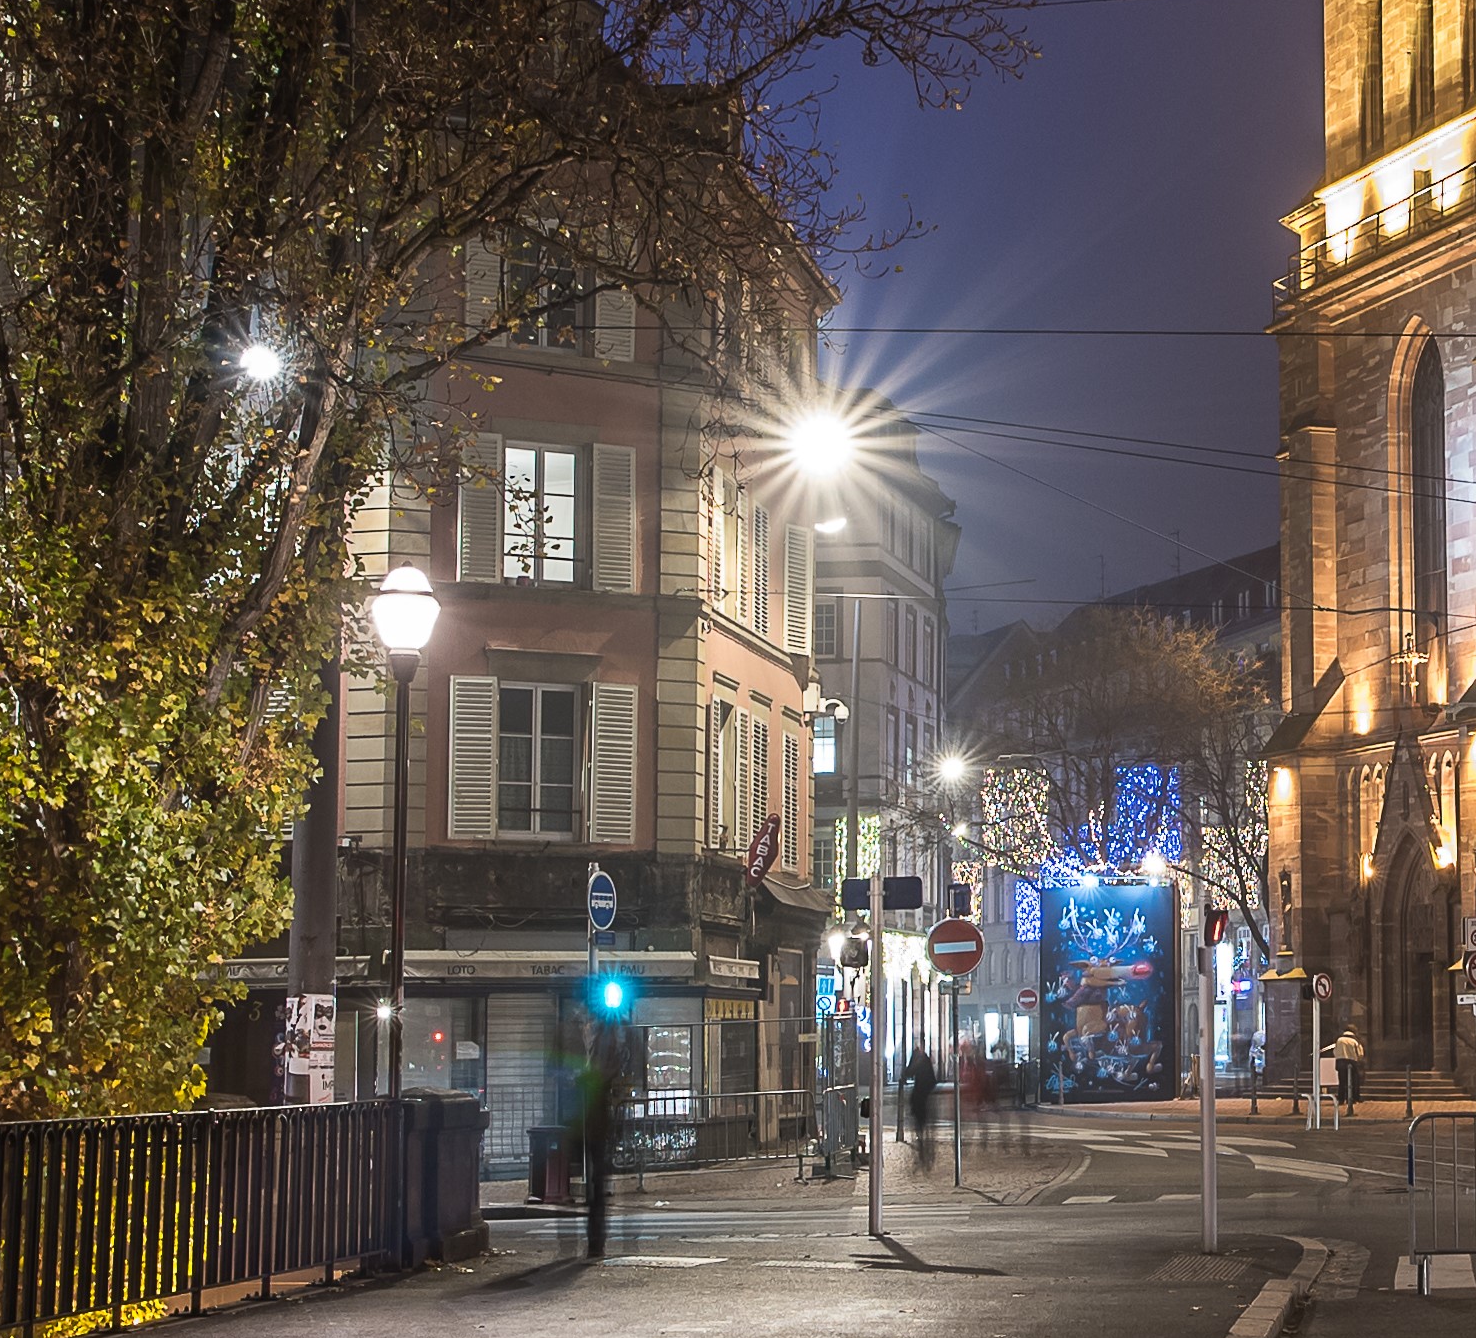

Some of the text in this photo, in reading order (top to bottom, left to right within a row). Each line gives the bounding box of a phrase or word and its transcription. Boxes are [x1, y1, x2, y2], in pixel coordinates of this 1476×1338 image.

[750, 822, 775, 878] TABAC
[447, 964, 645, 976] LOTO TABAC PMU
[249, 1001, 263, 1021] 3
